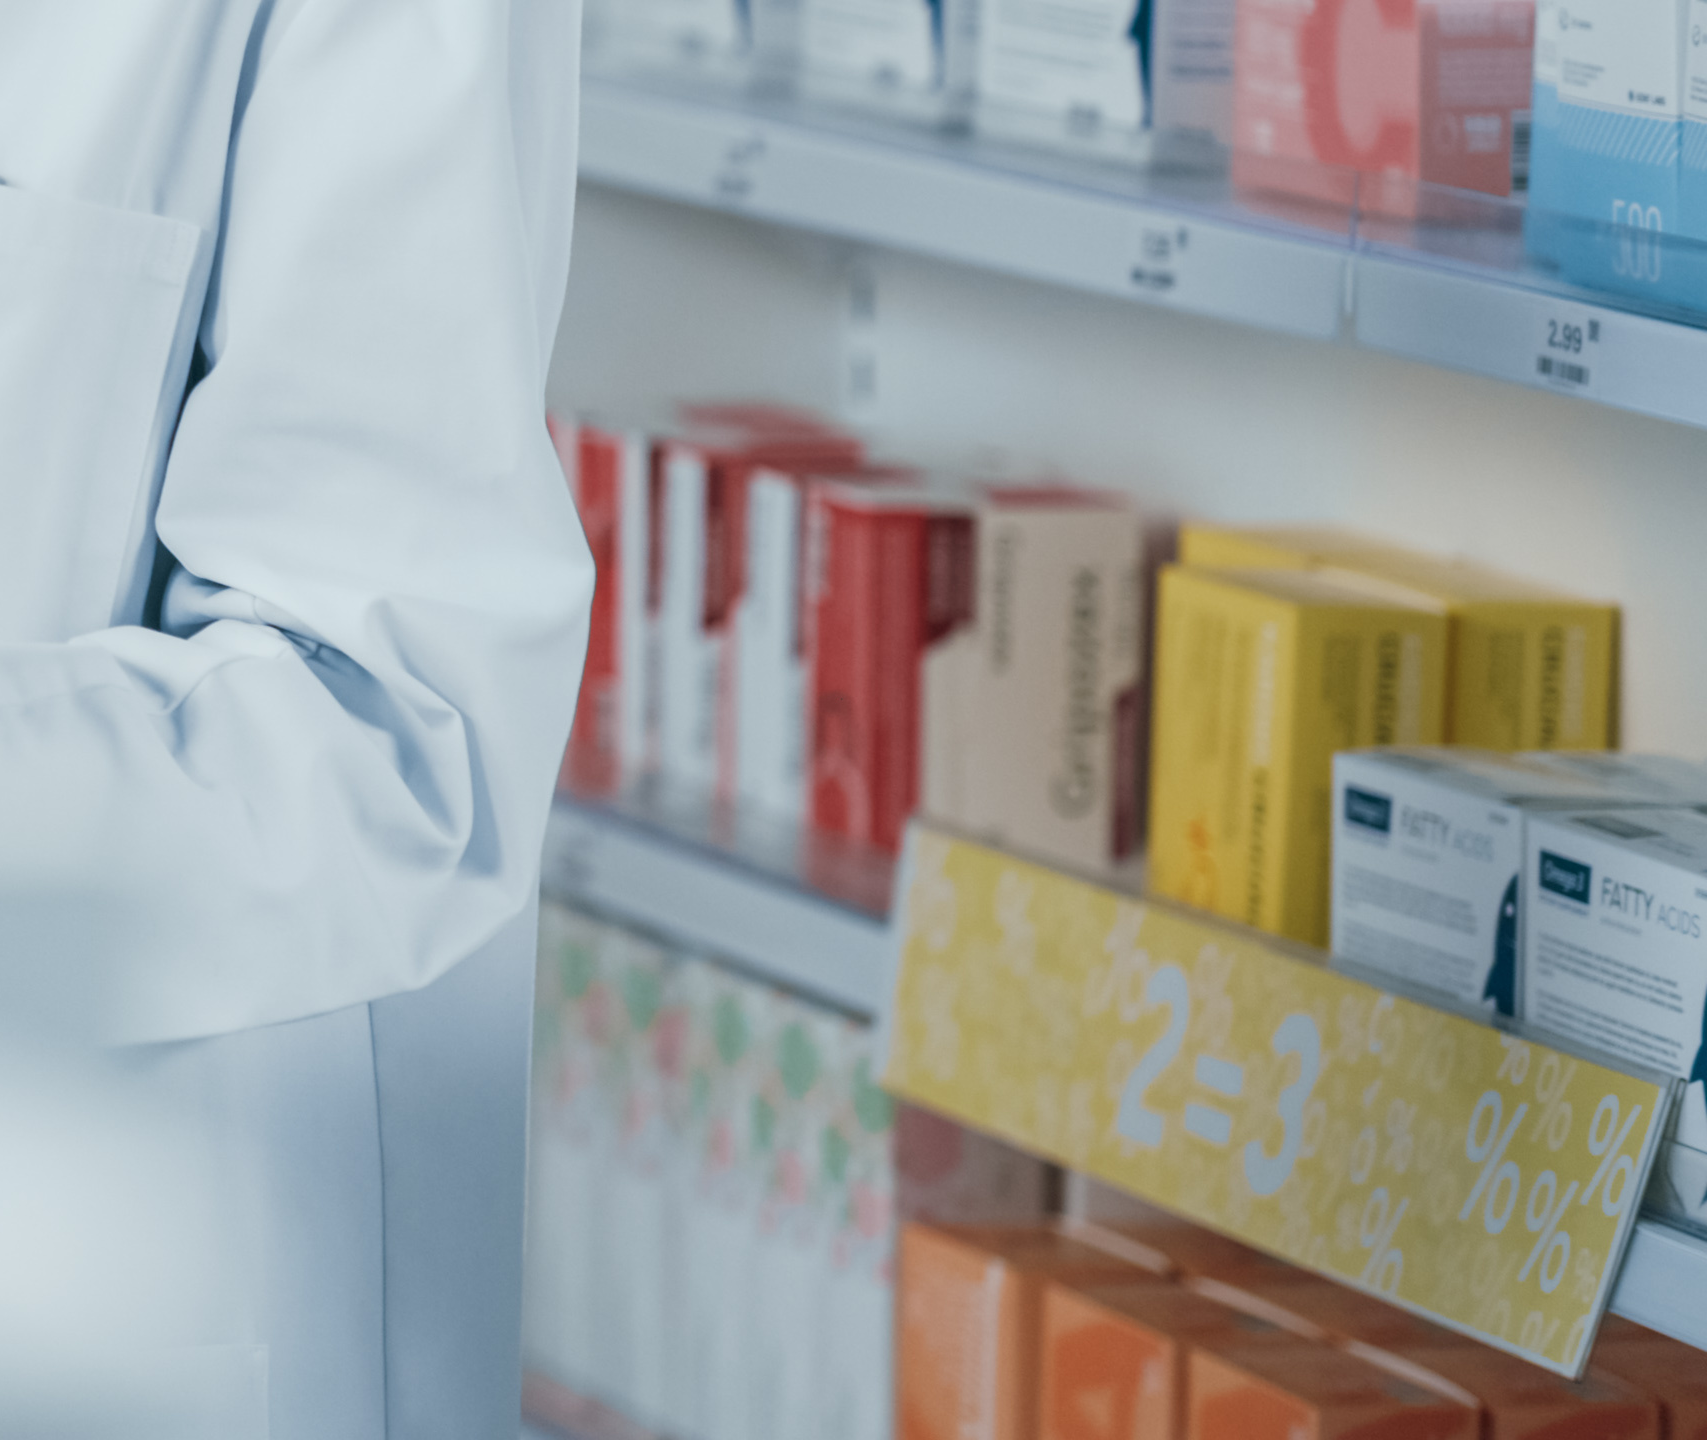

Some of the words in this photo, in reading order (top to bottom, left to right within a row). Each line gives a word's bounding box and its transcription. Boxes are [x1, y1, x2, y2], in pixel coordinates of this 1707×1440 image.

[1610, 196, 1662, 283] 500
[1547, 318, 1583, 354] 2.99
[1601, 876, 1655, 922] FATTY
[1656, 903, 1701, 939] ACIDS
